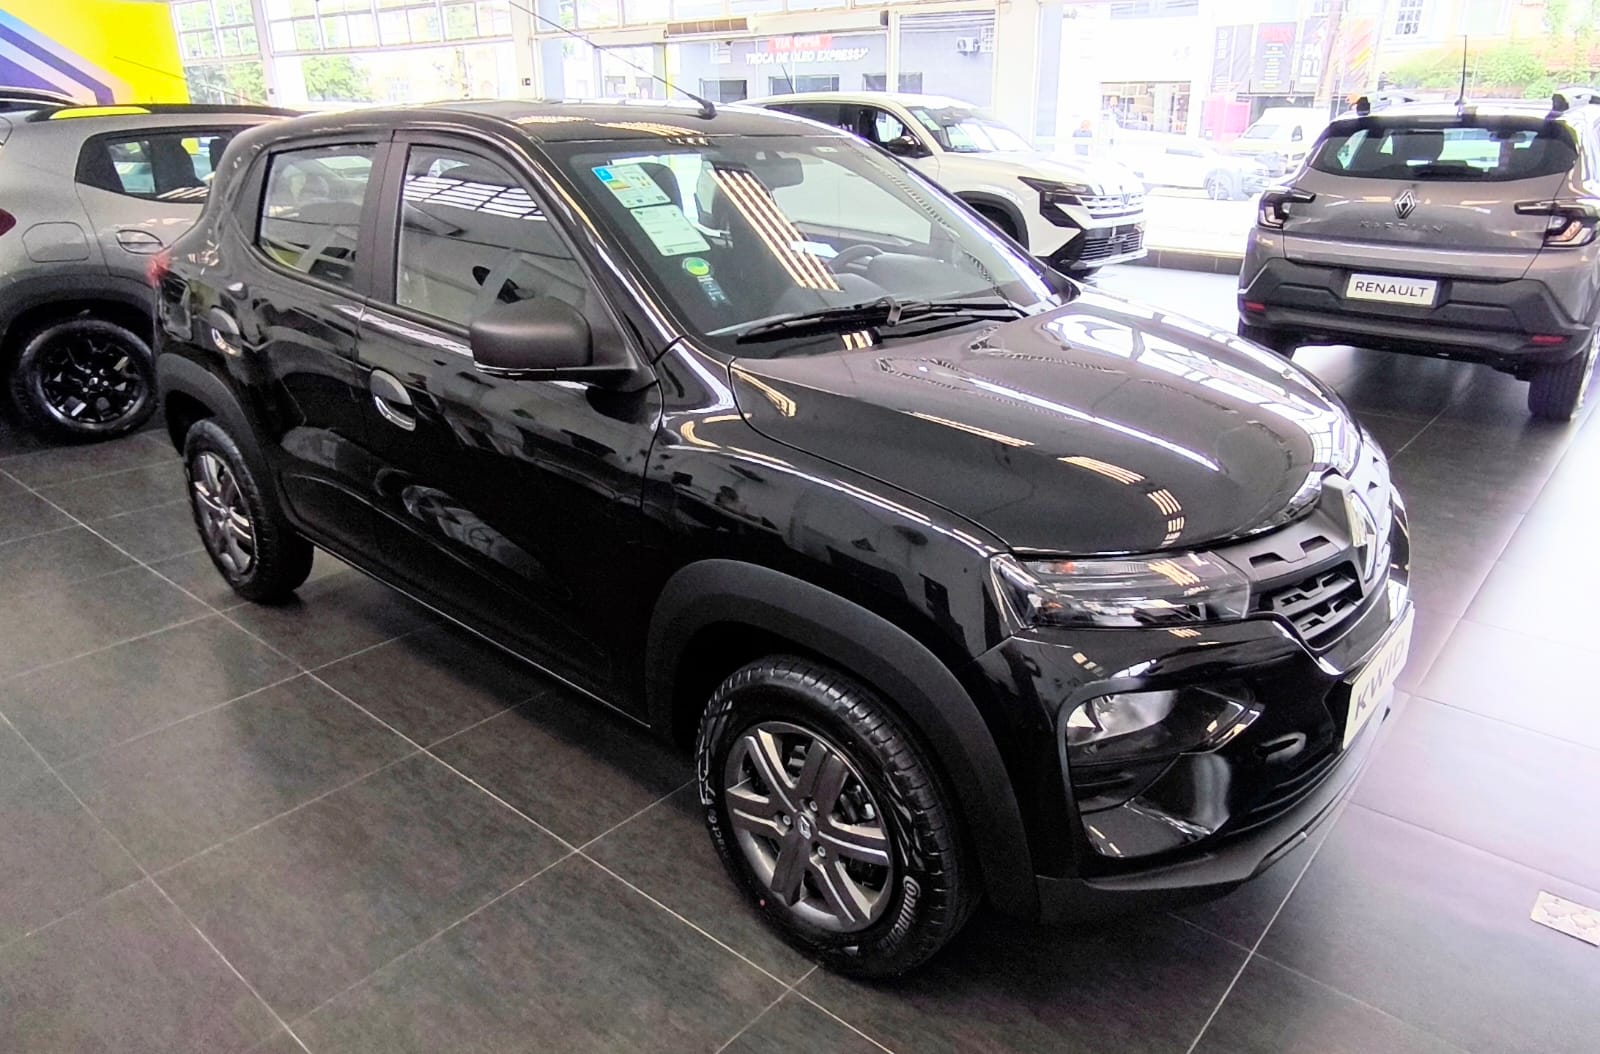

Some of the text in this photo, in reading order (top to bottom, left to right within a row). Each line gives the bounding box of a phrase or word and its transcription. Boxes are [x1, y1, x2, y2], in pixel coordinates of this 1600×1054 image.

[746, 52, 774, 64] TROCA
[776, 52, 789, 63] DE
[1355, 281, 1429, 298] RENAULT
[1354, 640, 1405, 711] KWID
